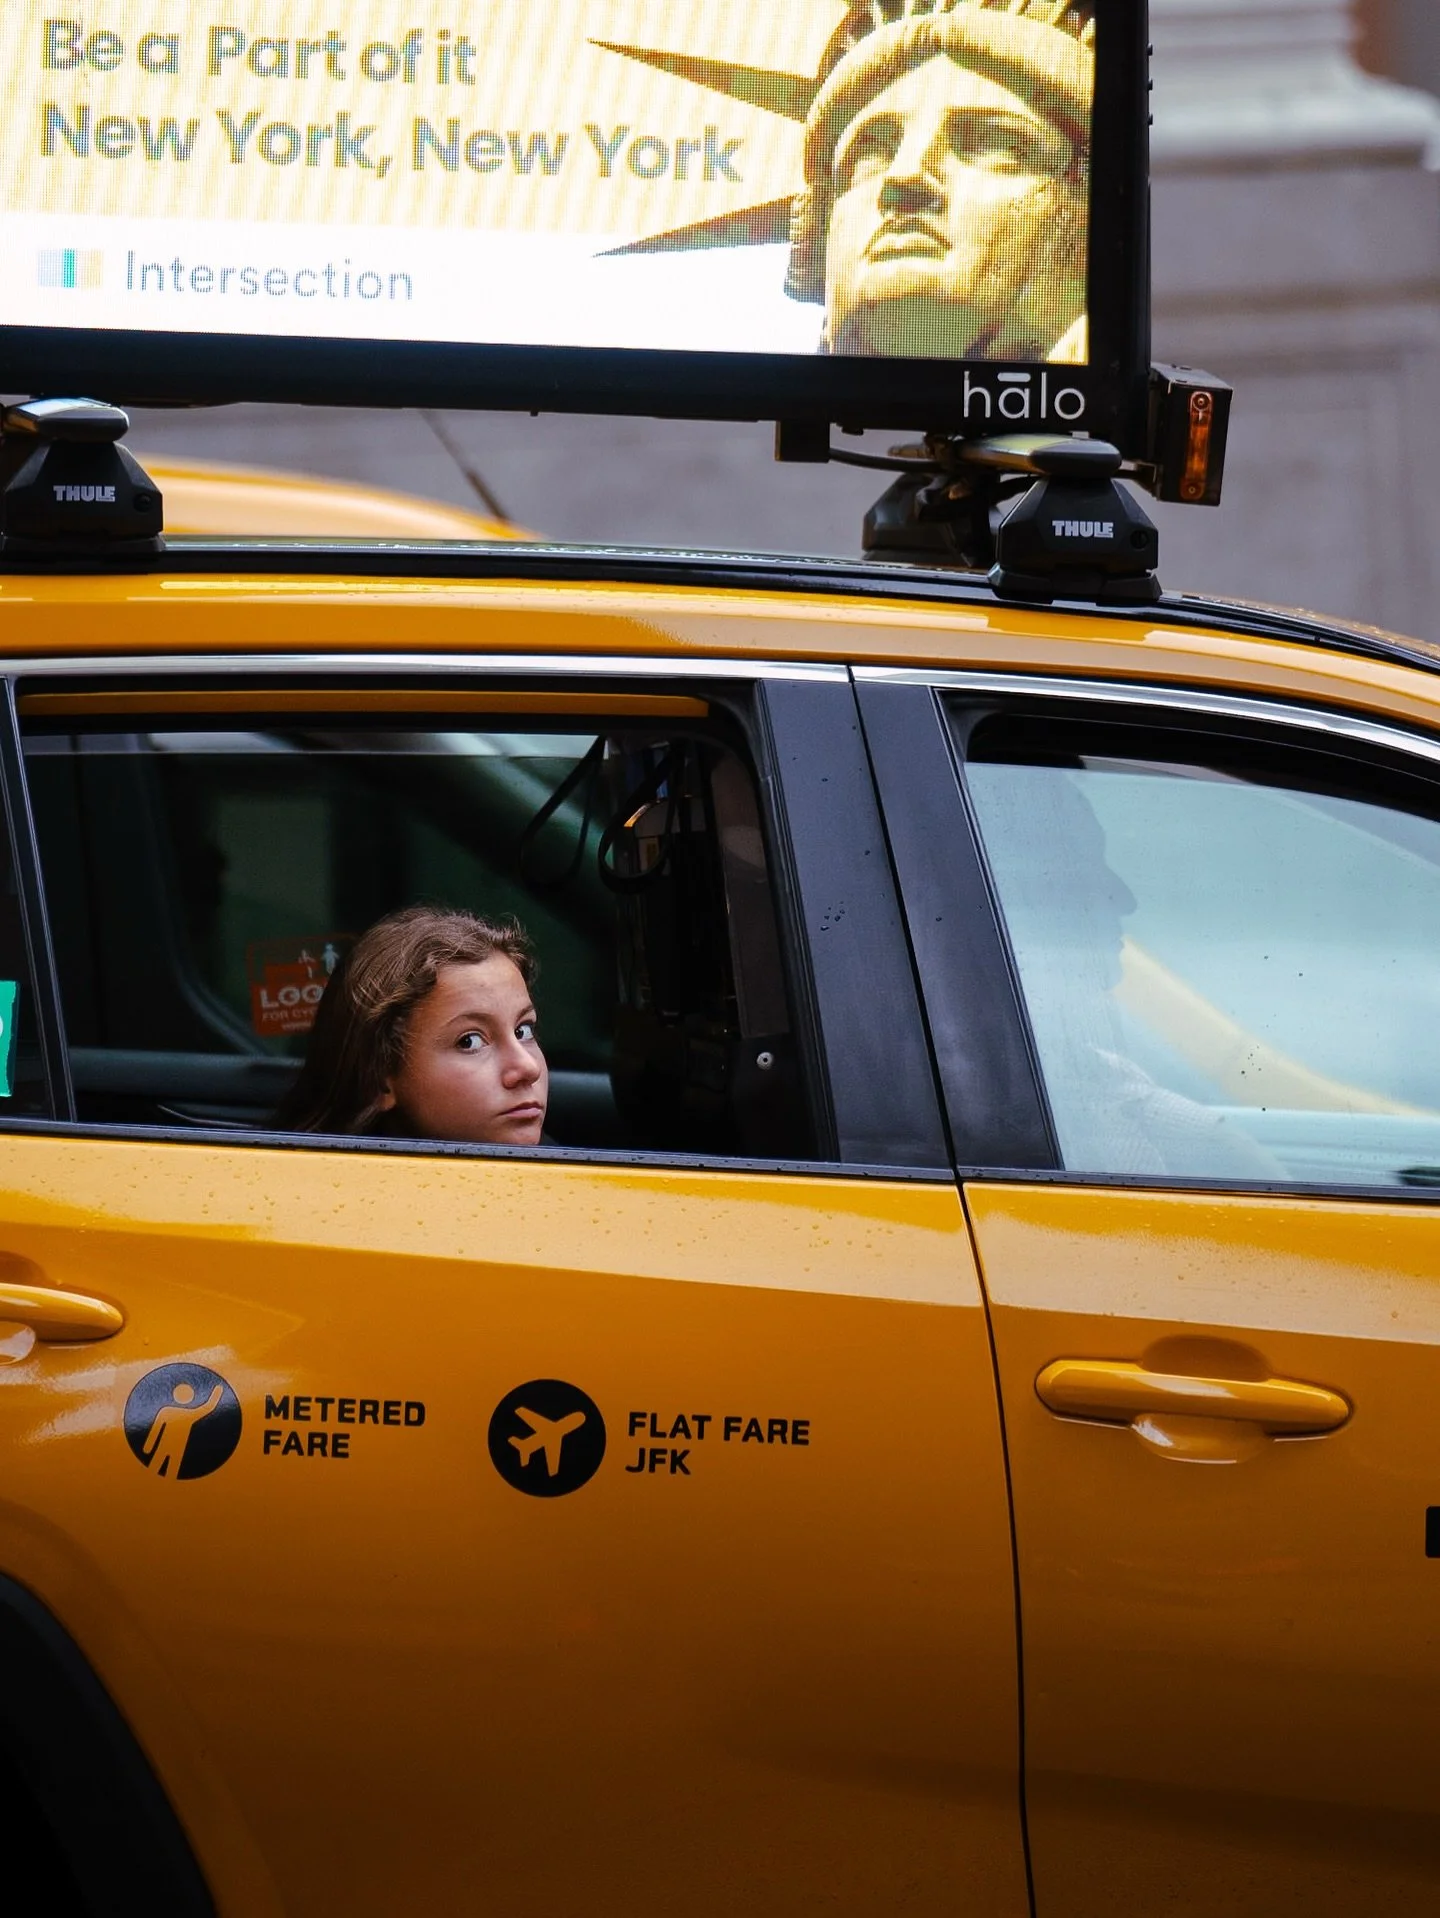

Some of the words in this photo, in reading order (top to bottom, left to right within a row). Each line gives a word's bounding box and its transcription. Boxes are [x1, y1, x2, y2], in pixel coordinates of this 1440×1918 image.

[42, 18, 125, 72] Be
[137, 32, 180, 74] a
[208, 24, 347, 81] Part
[360, 28, 423, 84] of
[436, 28, 476, 85] it
[41, 99, 201, 162] New
[215, 107, 393, 179] York,
[412, 114, 570, 176] New
[583, 121, 745, 182] York
[125, 248, 414, 301] Intersection
[53, 485, 116, 502] THULE
[1052, 520, 1114, 539] THULE
[260, 983, 324, 1009] LOO
[264, 1395, 426, 1427] METERED
[628, 1411, 712, 1441] FLAT
[723, 1416, 811, 1446] FARE
[263, 1430, 351, 1459] FARE
[625, 1447, 692, 1476] JFK
